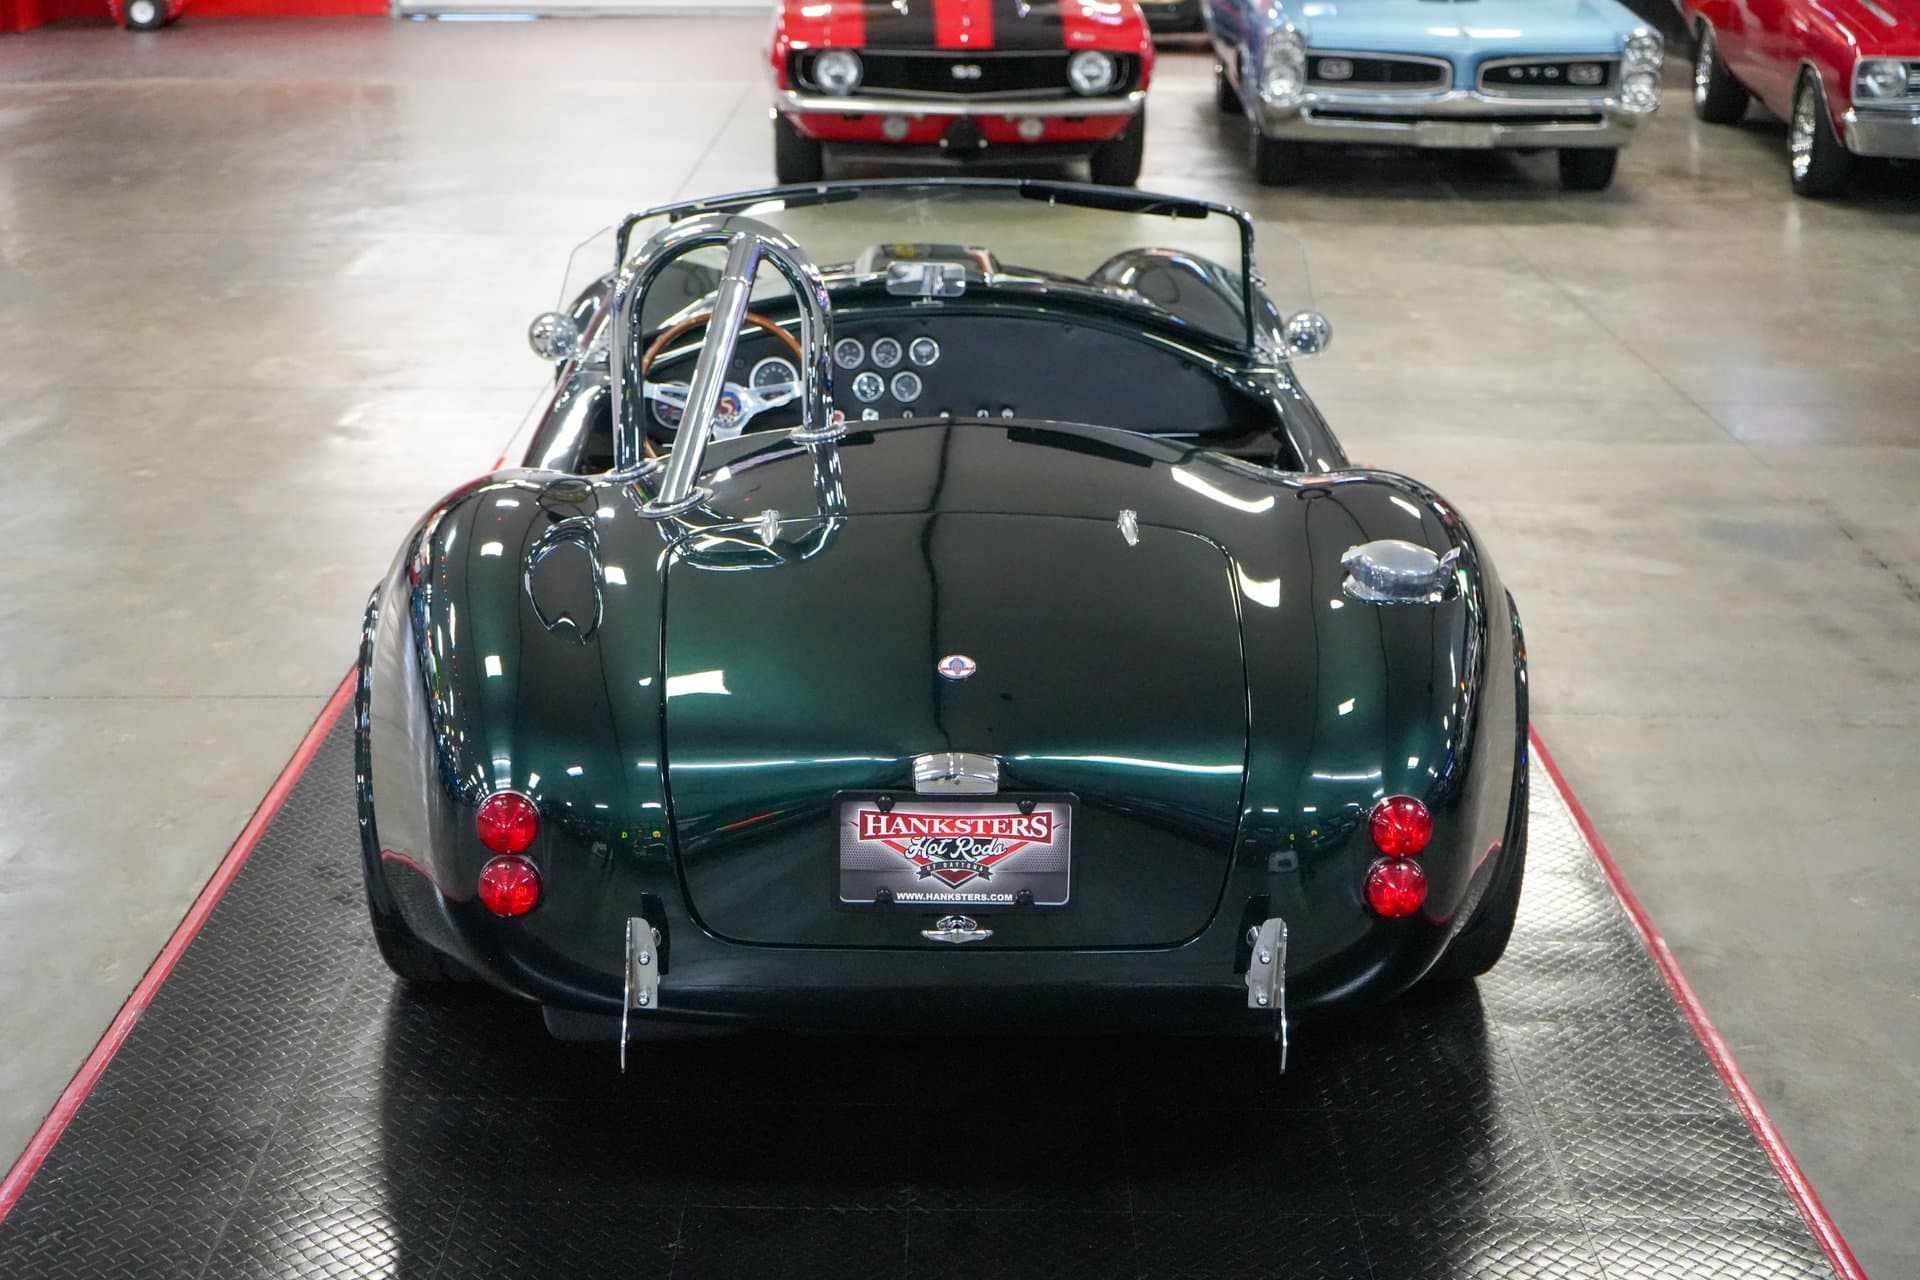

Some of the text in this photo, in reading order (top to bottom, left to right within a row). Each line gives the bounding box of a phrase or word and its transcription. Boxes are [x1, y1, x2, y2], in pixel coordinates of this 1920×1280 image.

[863, 813, 1048, 838] HANKSTERS
[905, 836, 1007, 861] Hot Rods
[896, 892, 1013, 901] WWW.HANKSTERS.COM
